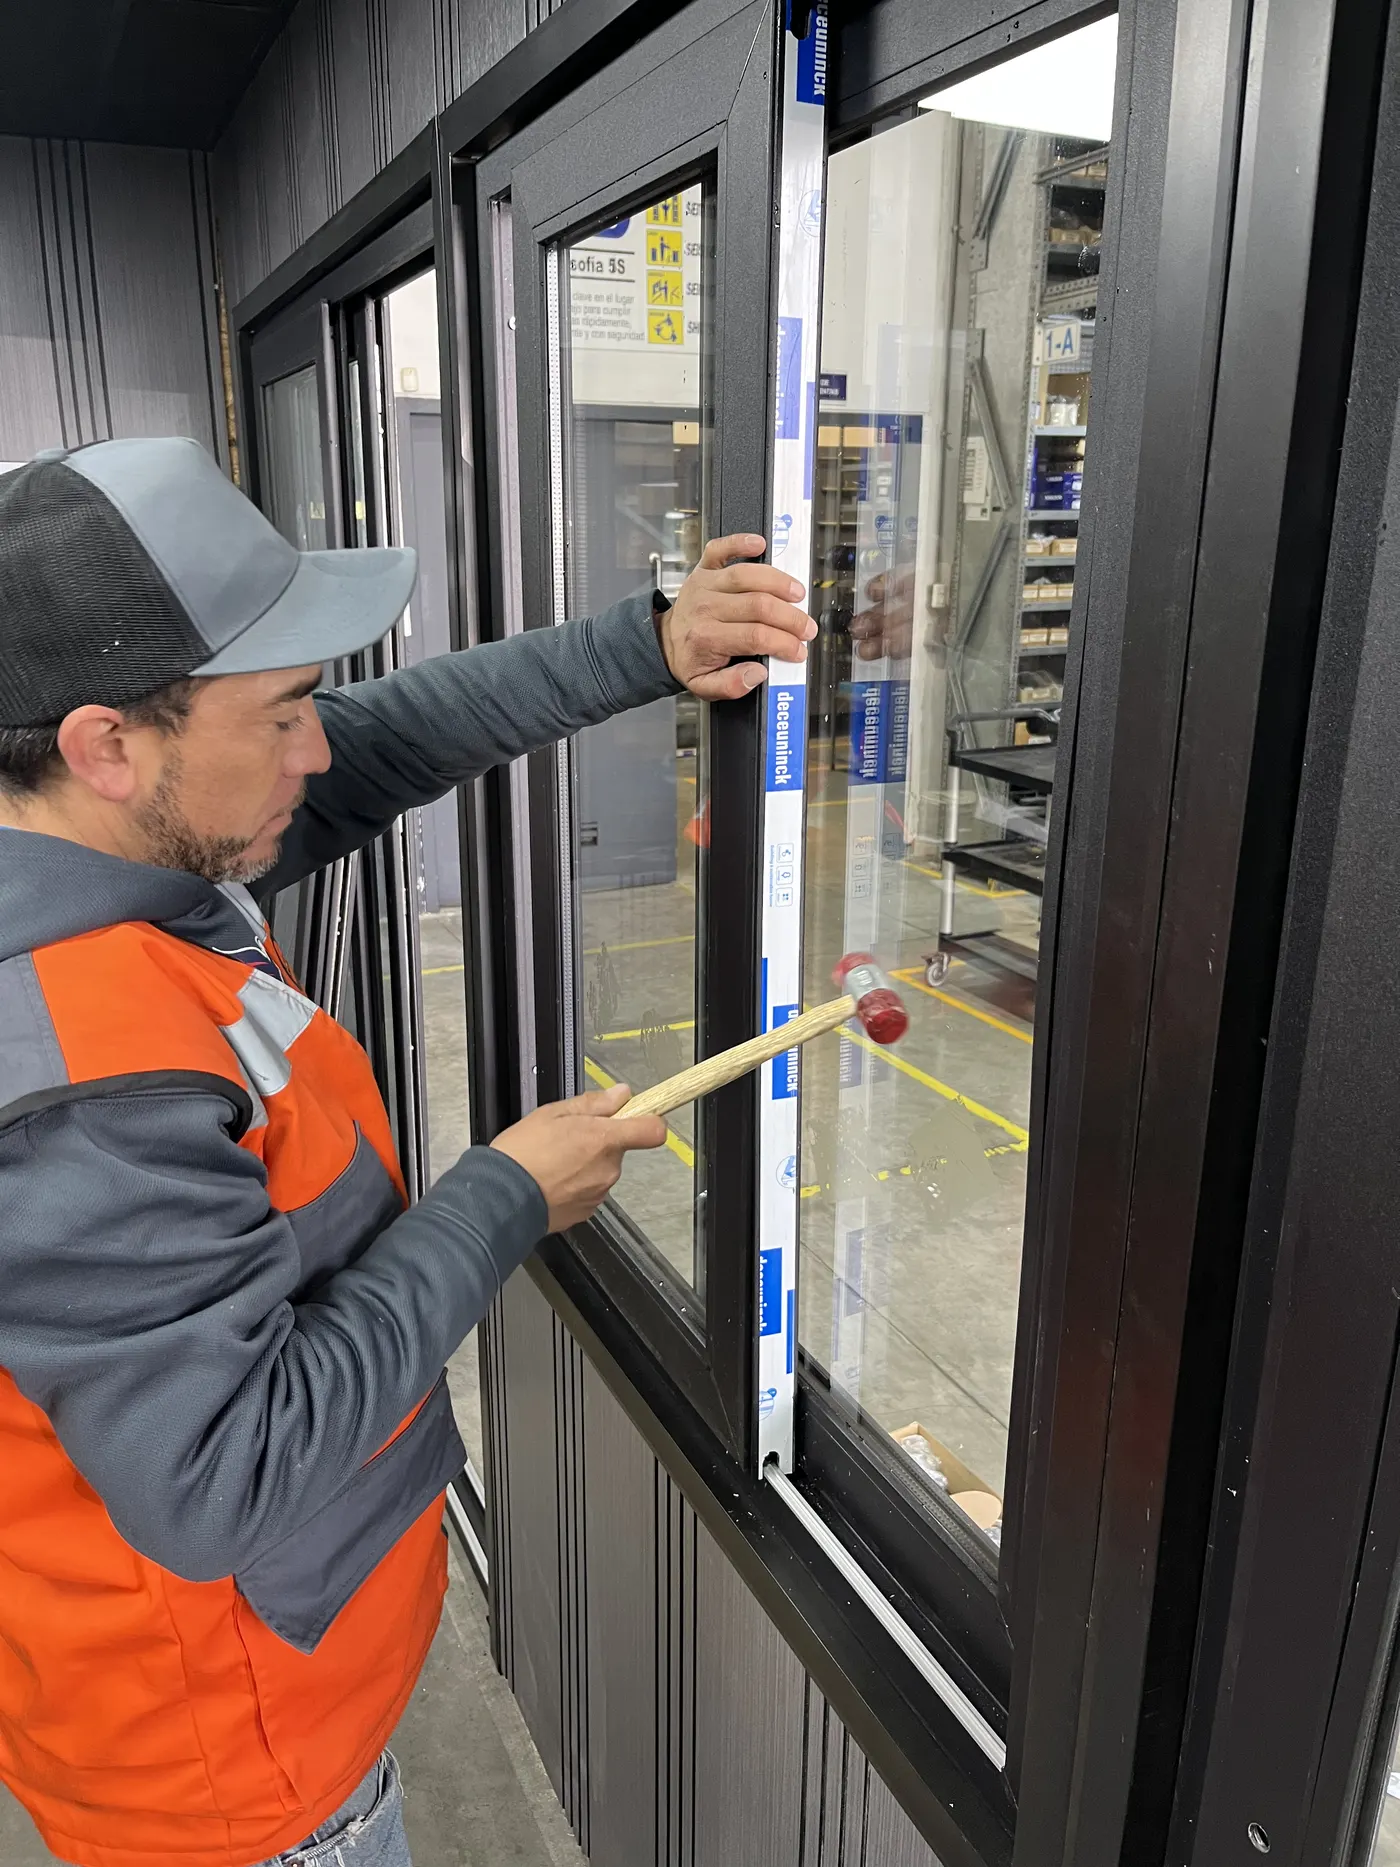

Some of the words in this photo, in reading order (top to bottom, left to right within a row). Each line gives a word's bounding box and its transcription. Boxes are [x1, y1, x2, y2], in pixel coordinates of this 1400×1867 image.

[608, 258, 626, 274] 5S
[615, 293, 635, 305] lugar
[1045, 327, 1074, 358] 1-A
[774, 691, 794, 785] deceuninck
